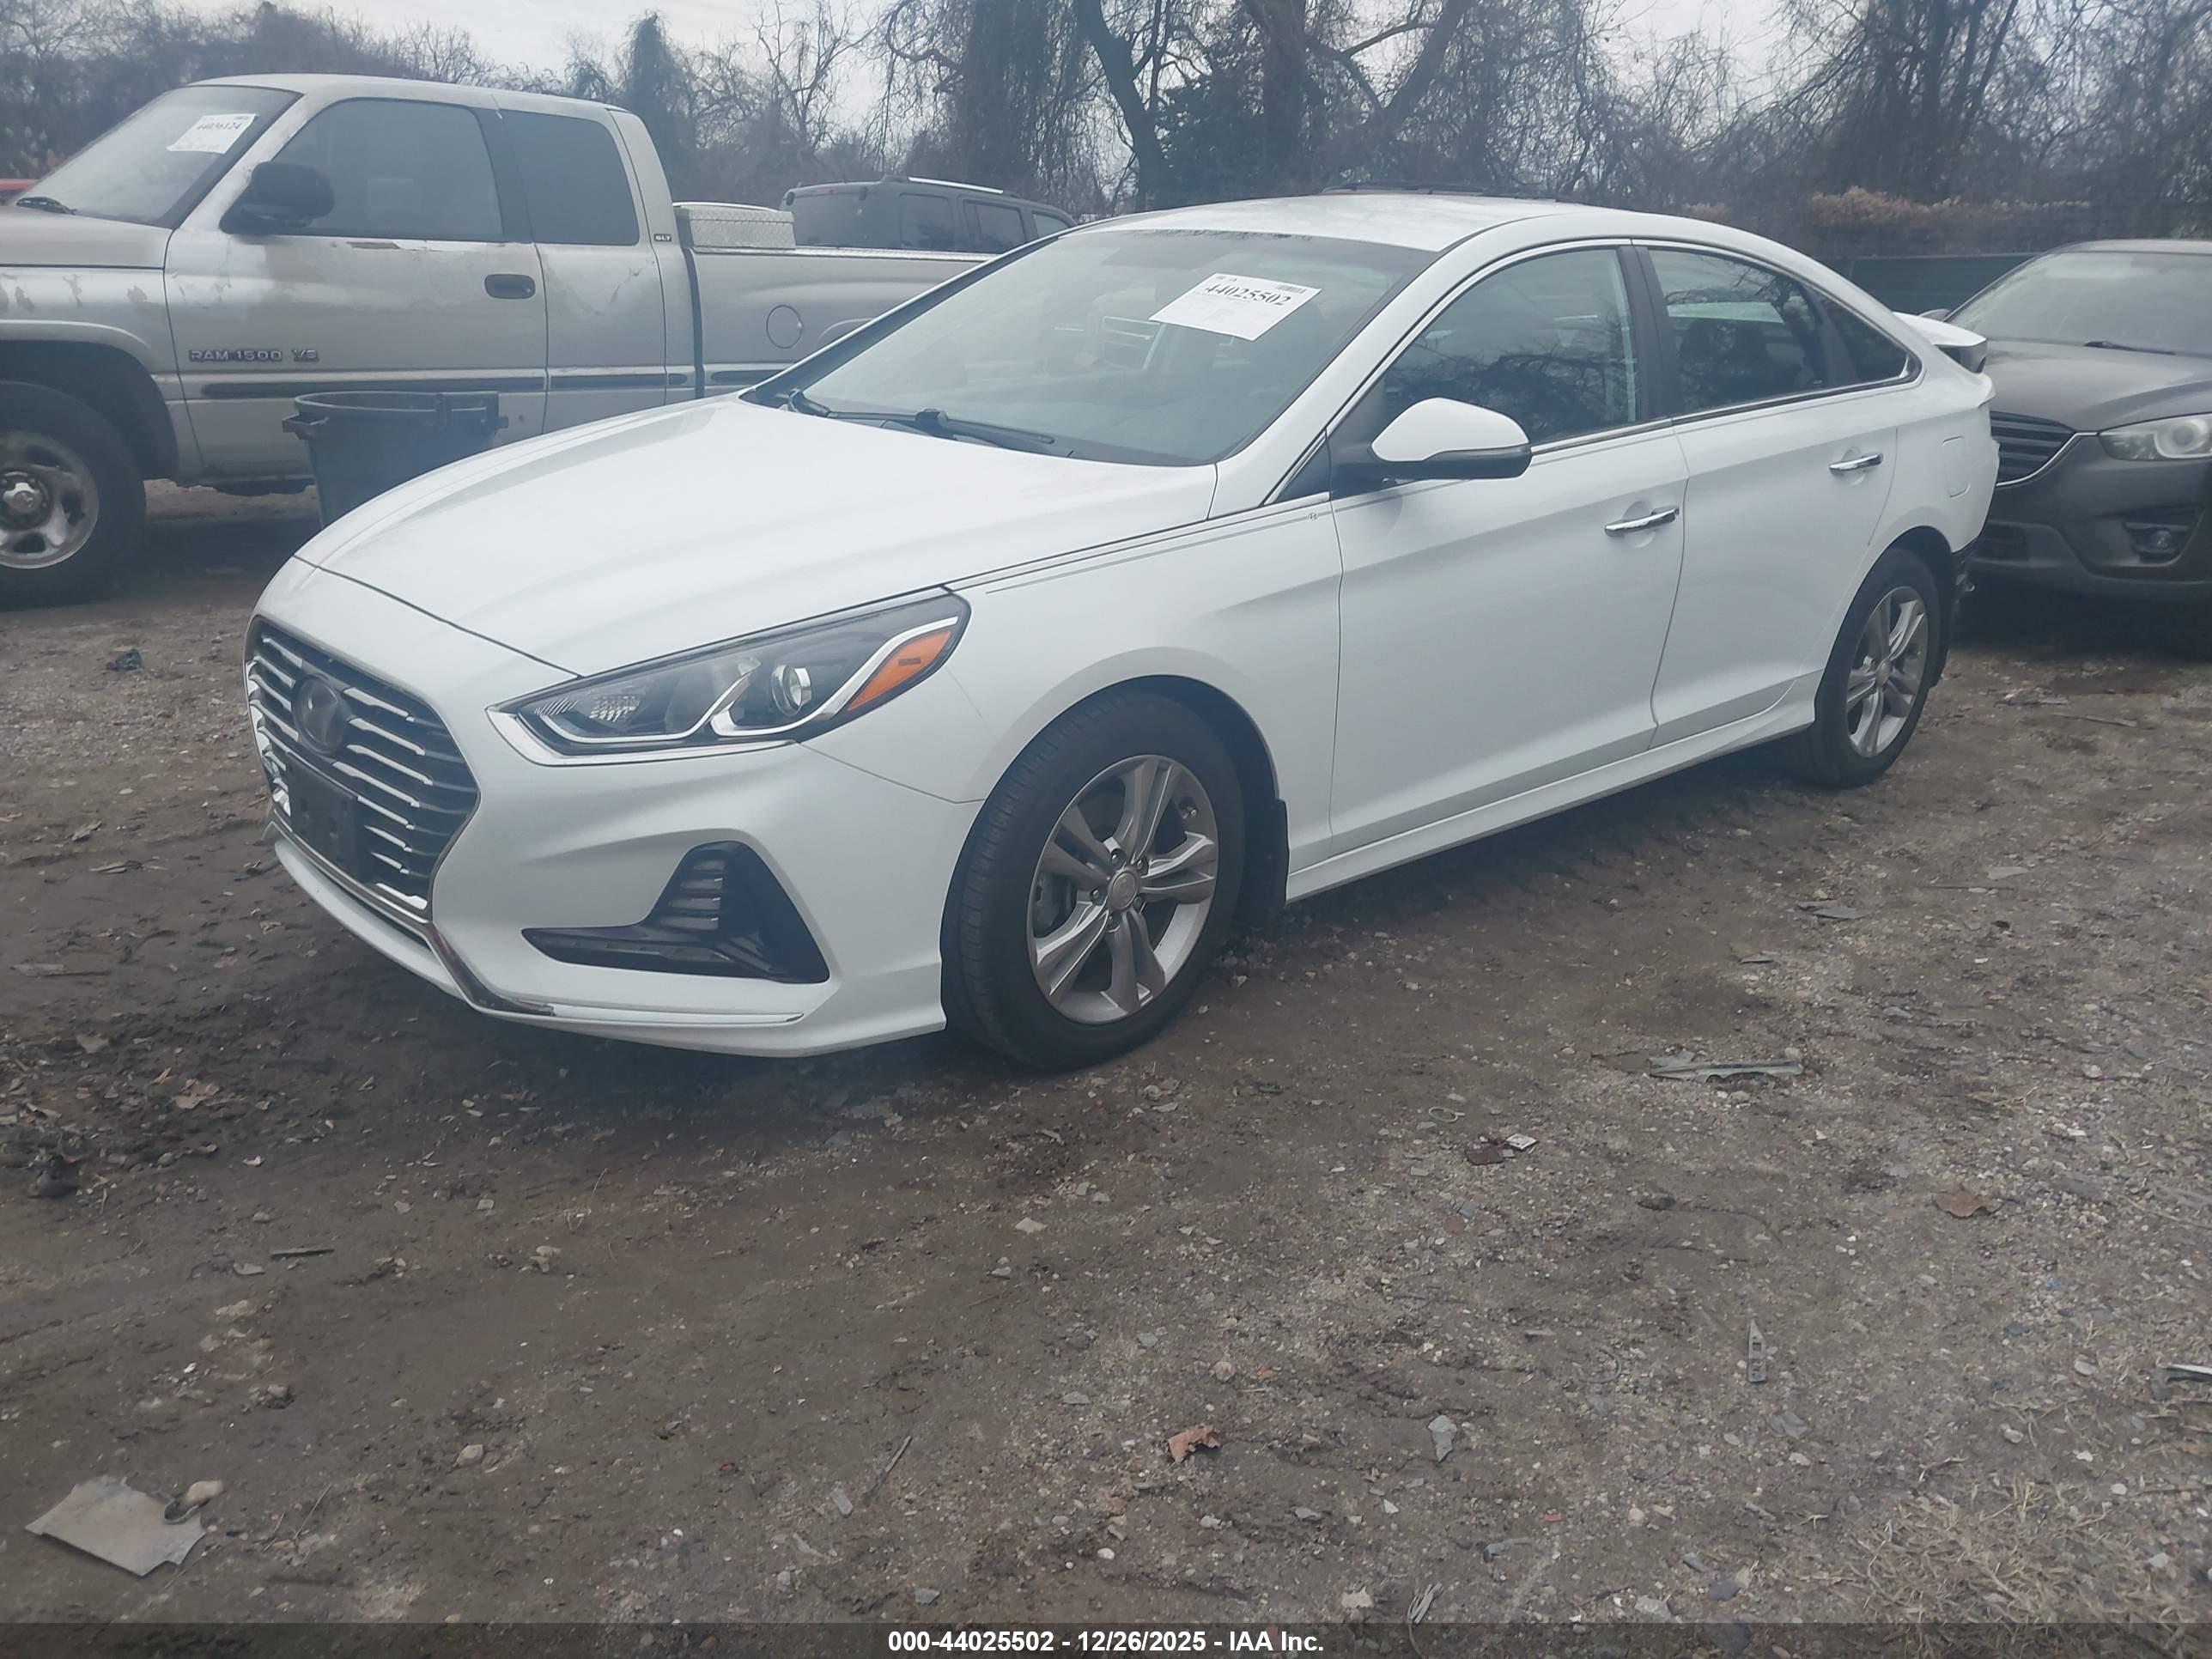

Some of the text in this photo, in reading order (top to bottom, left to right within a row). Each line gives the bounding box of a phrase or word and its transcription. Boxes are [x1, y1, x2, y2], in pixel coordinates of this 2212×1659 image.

[1205, 283, 1291, 306] 44025502
[191, 349, 229, 362] RAM
[236, 349, 283, 362] 1500
